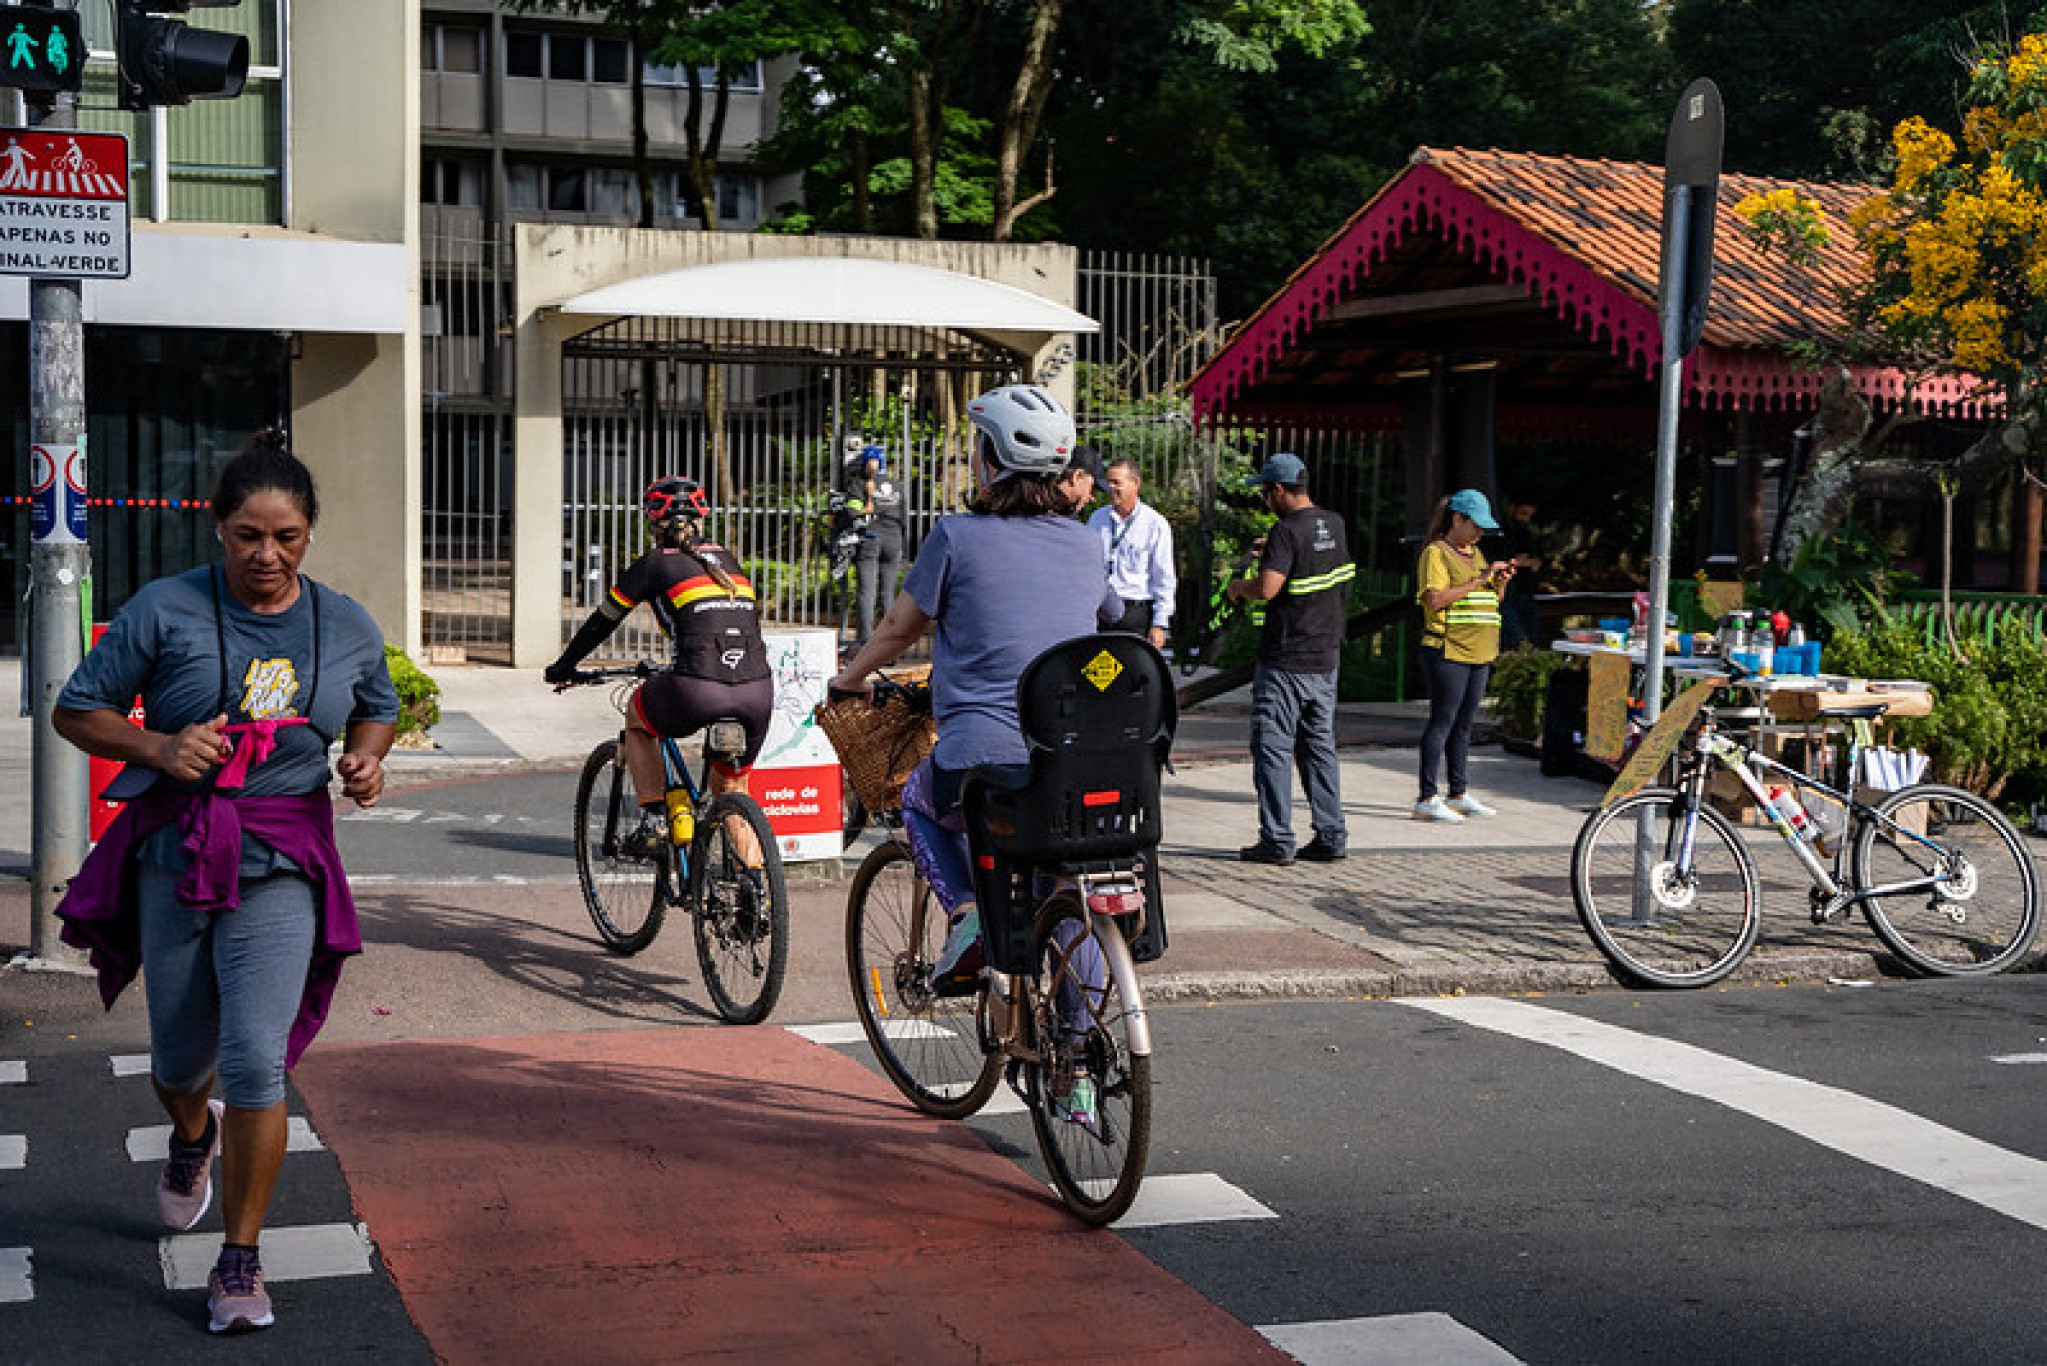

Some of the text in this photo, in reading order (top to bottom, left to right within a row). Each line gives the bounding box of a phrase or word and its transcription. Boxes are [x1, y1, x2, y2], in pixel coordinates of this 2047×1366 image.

[84, 230, 111, 246] NO
[765, 786, 818, 800] rede de
